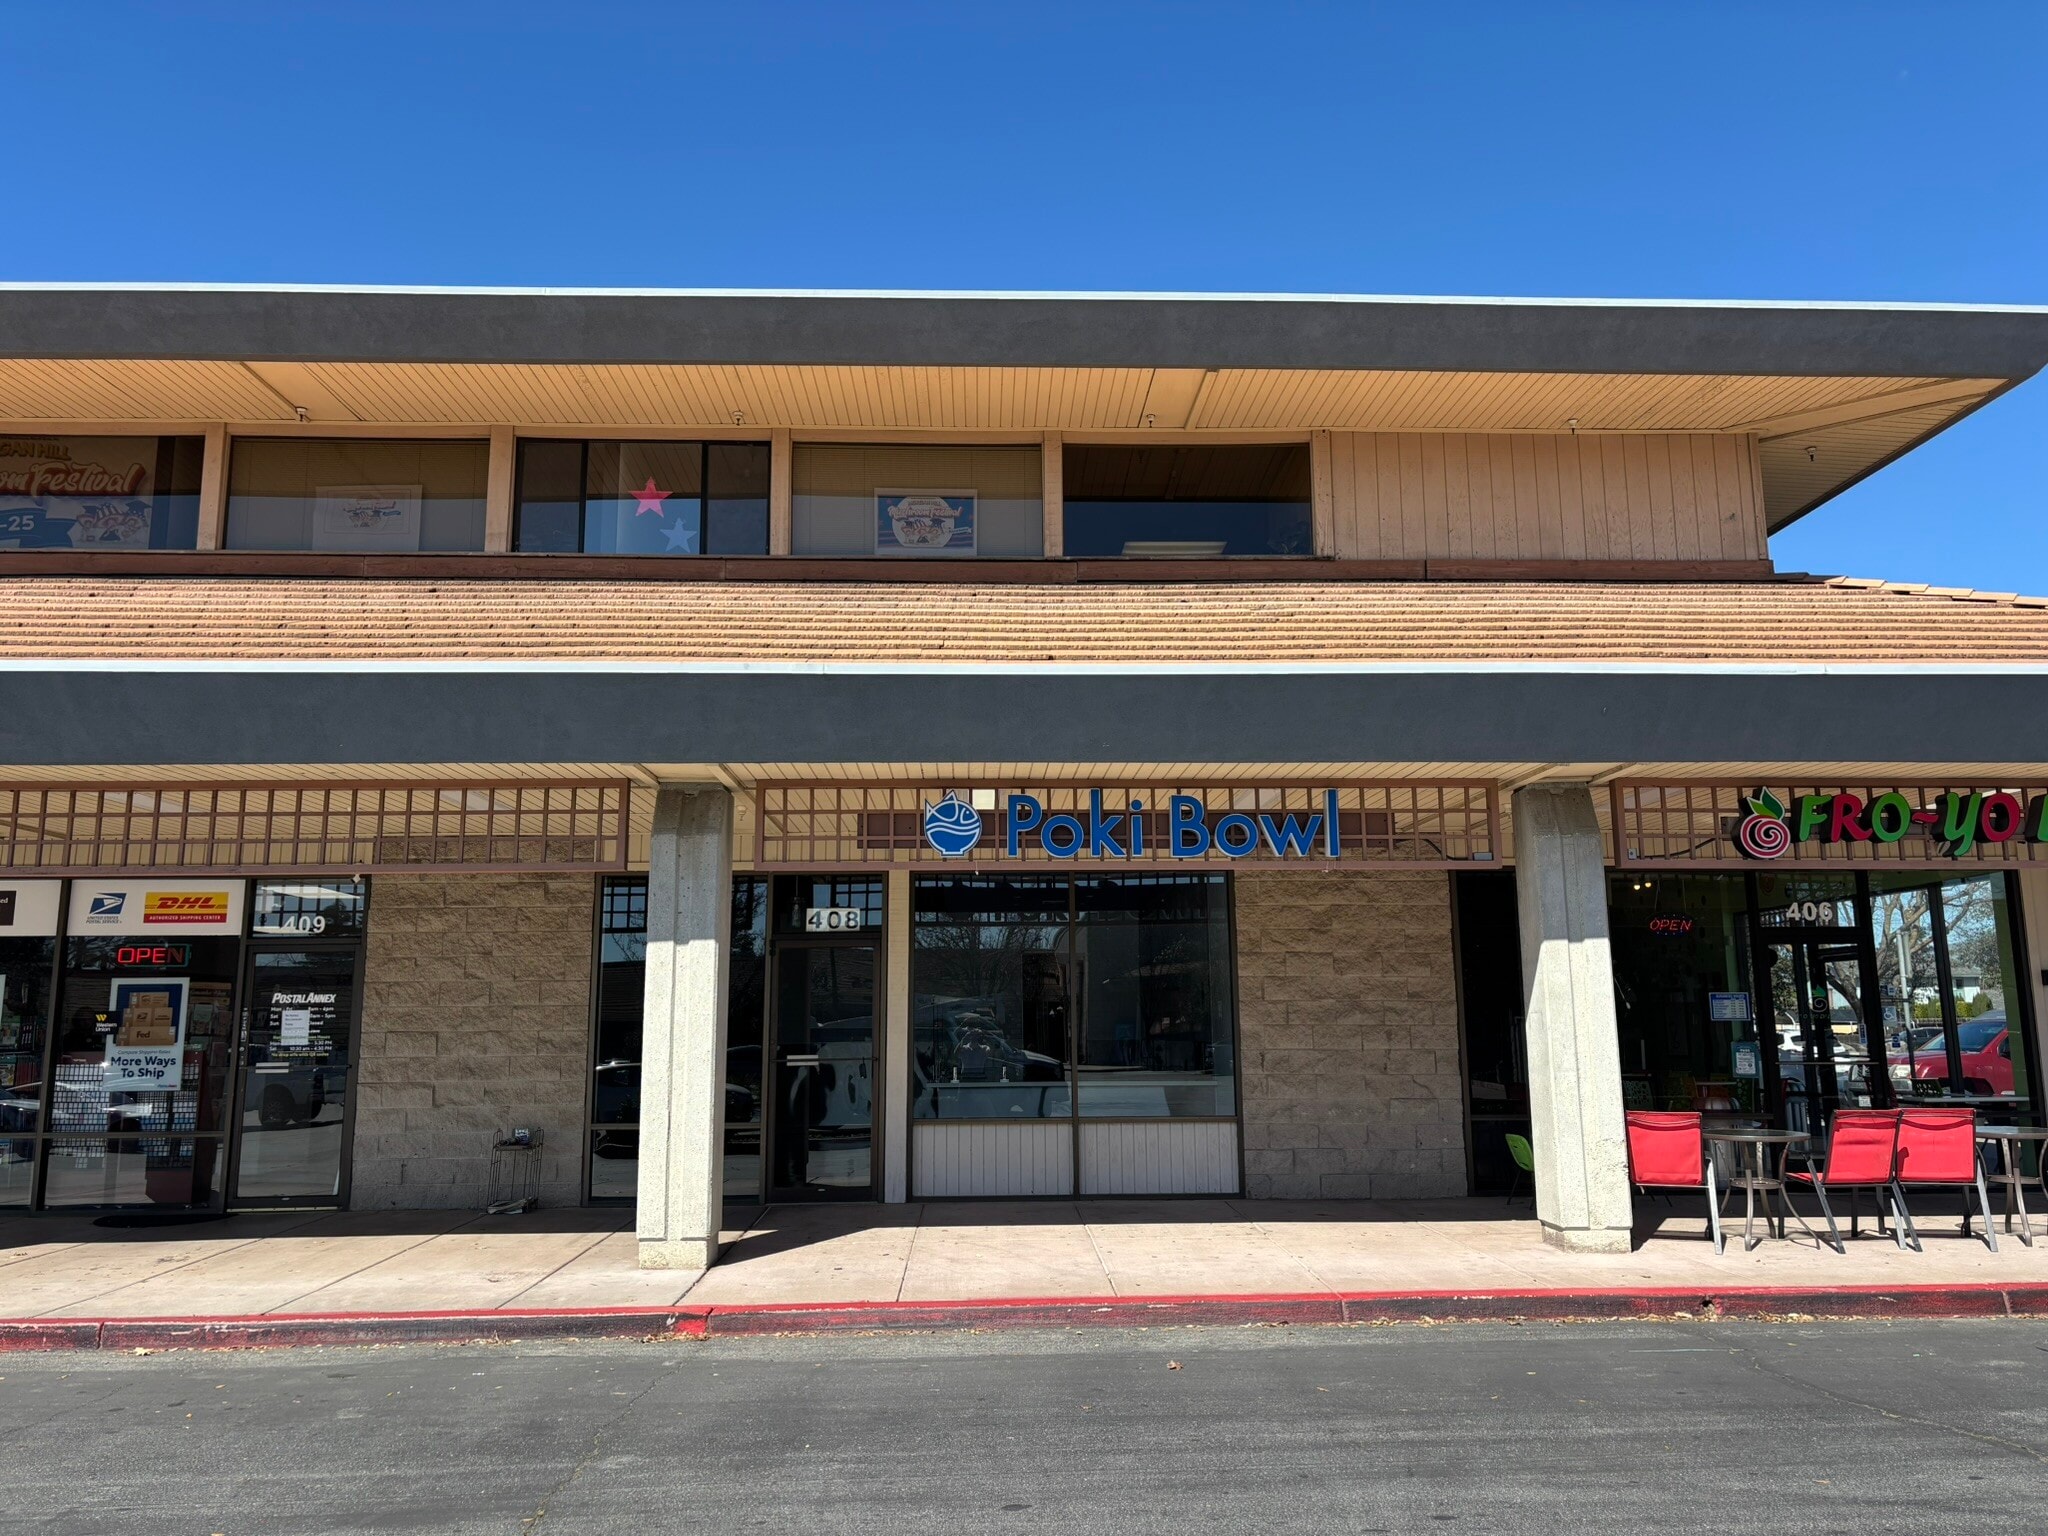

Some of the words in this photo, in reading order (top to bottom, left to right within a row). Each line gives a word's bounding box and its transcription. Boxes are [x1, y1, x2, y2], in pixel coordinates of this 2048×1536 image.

[37, 443, 72, 461] HILL
[30, 460, 145, 500] Festival
[1006, 788, 1143, 858] Poki
[1169, 788, 1341, 858] Bowl
[157, 897, 216, 909] DHL
[1786, 901, 1833, 921] 406
[280, 915, 326, 934] 409
[808, 910, 859, 929] 408
[1649, 919, 1693, 931] OPEN
[117, 947, 184, 963] OPEN
[136, 1031, 151, 1039] Fed
[111, 1056, 142, 1066] More
[144, 1055, 177, 1068] Ways
[120, 1068, 135, 1078] To
[137, 1067, 165, 1079] Ship
